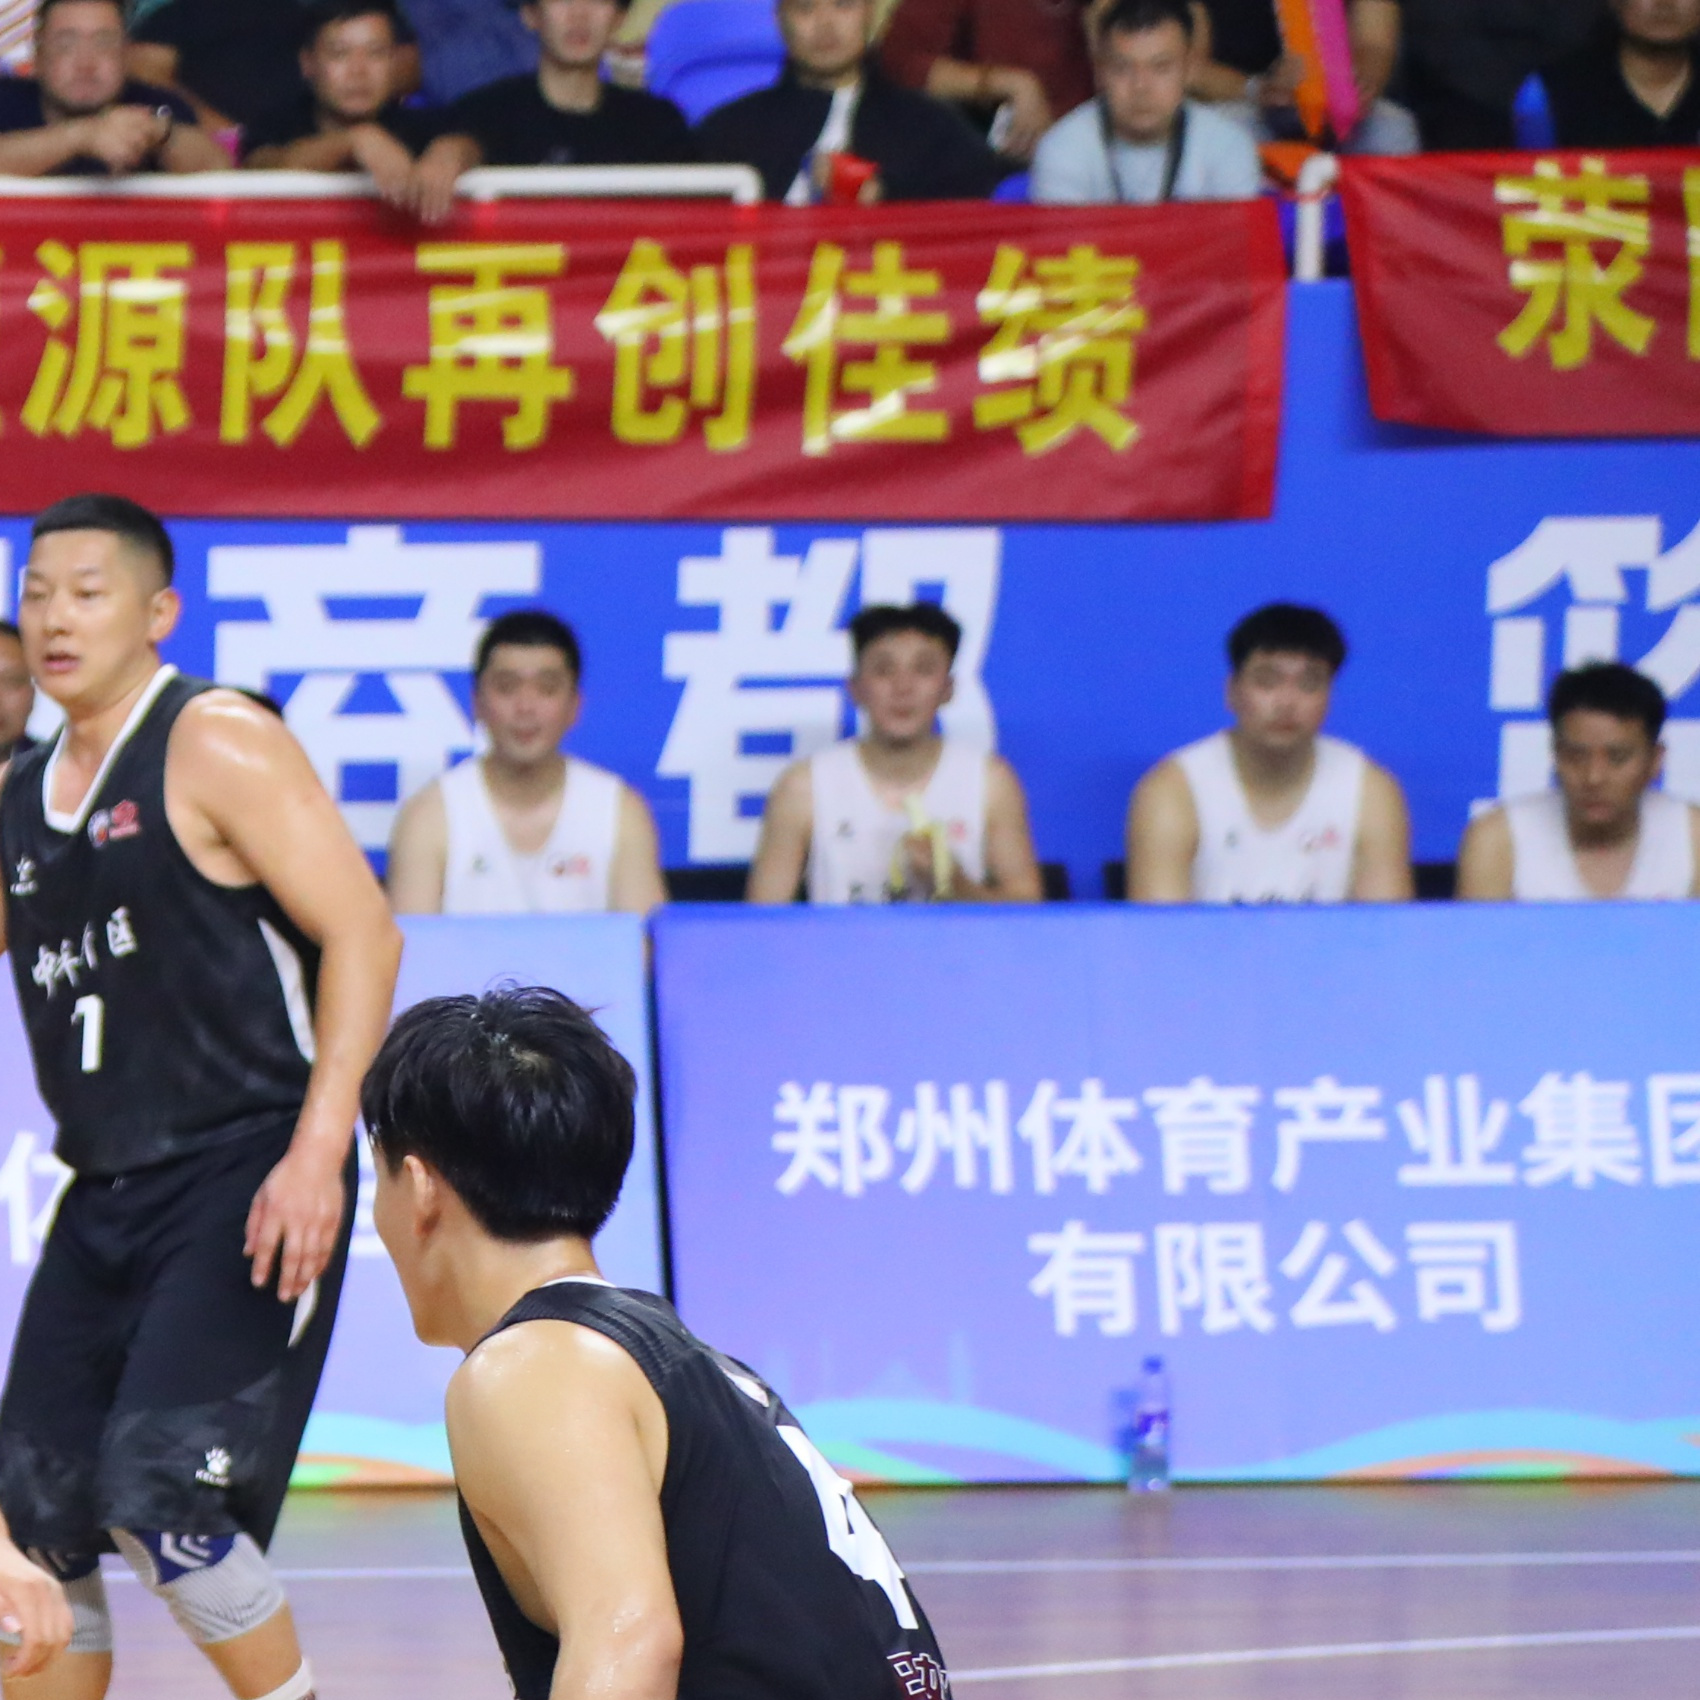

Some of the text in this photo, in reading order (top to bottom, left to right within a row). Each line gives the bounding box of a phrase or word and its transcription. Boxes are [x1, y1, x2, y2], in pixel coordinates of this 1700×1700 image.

[1493, 156, 1700, 370] 荥
[1028, 1219, 1522, 1339] 有限公司
[776, 1424, 920, 1630] 4
